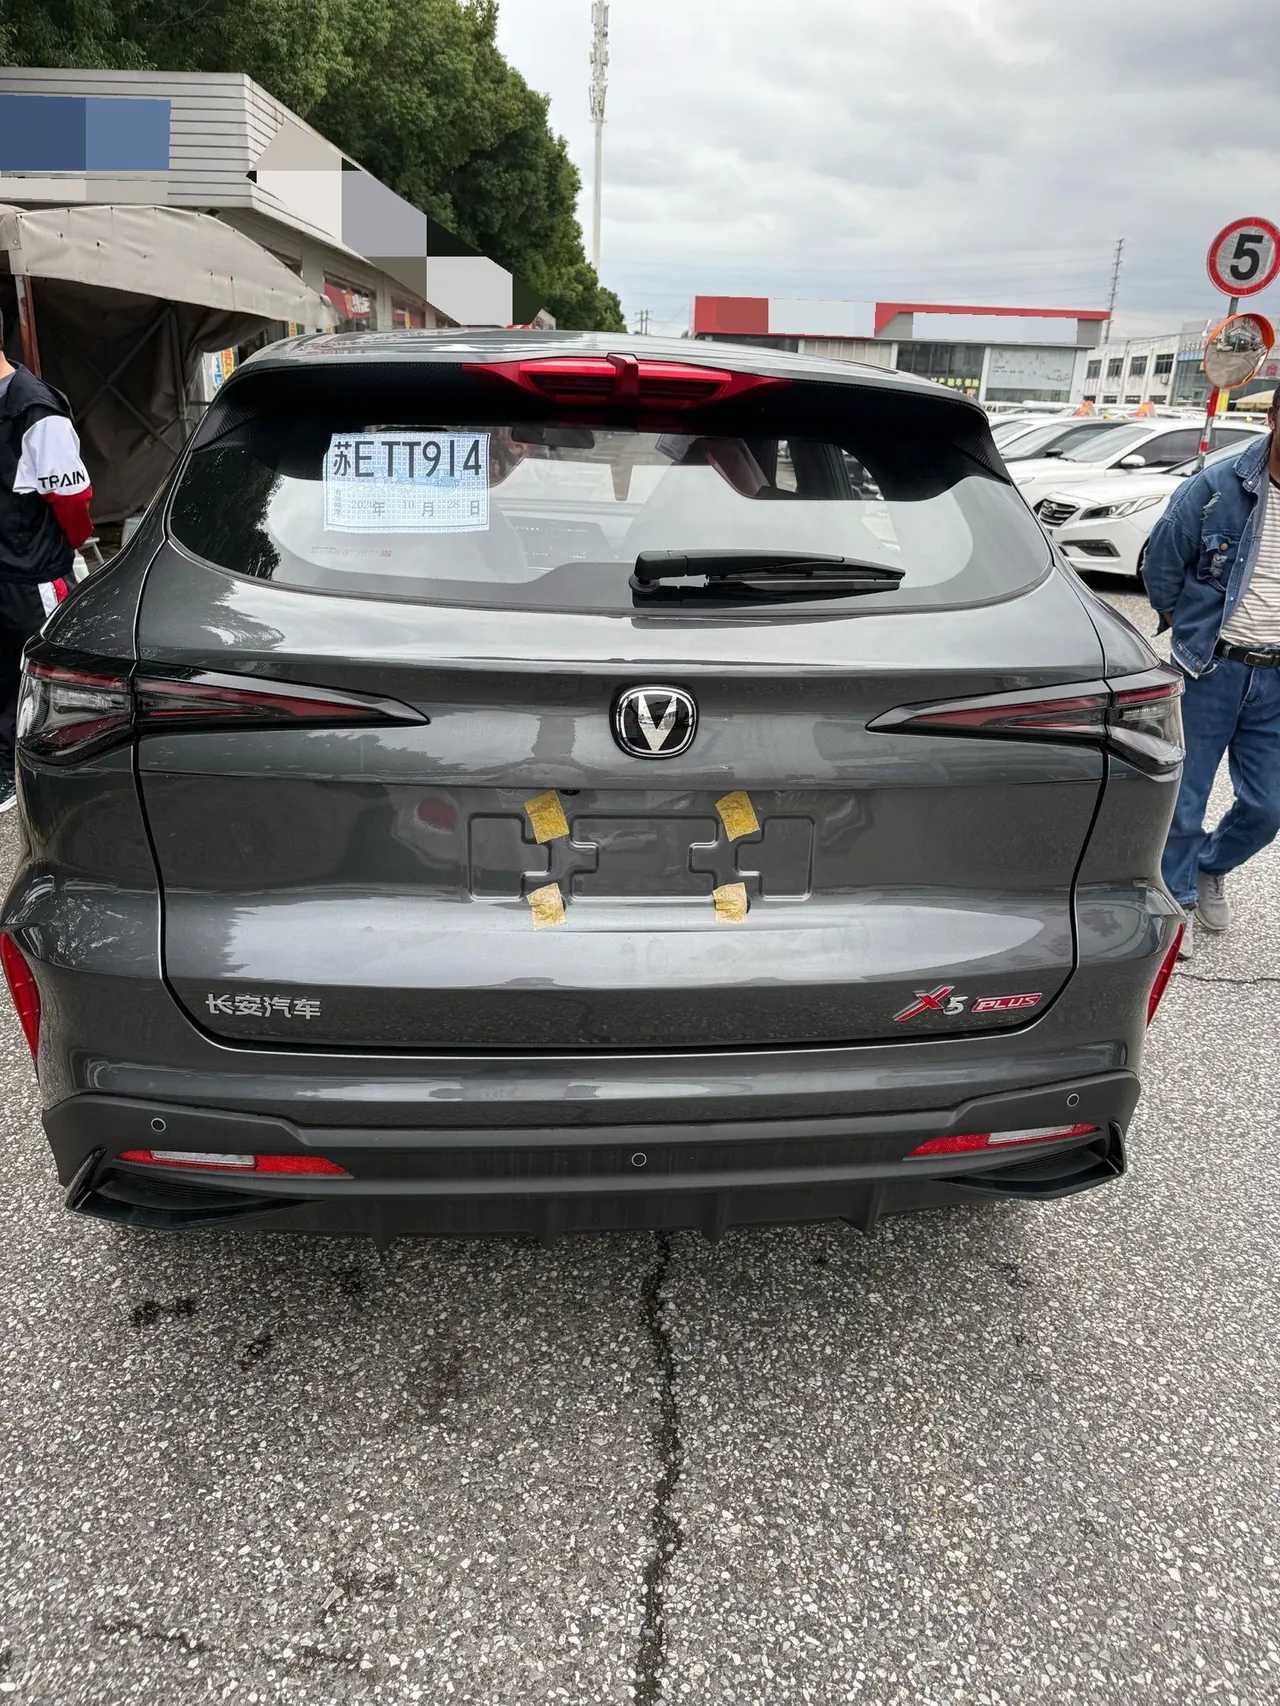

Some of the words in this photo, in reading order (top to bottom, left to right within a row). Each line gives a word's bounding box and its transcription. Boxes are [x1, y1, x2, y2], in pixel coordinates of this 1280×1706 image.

[1229, 233, 1264, 281] 5
[333, 439, 482, 478] 苏ETT914
[38, 470, 86, 489] TRAIN
[205, 993, 322, 1020] 长安汽车
[893, 984, 968, 1022] X5
[976, 994, 1040, 1011] PLUS
